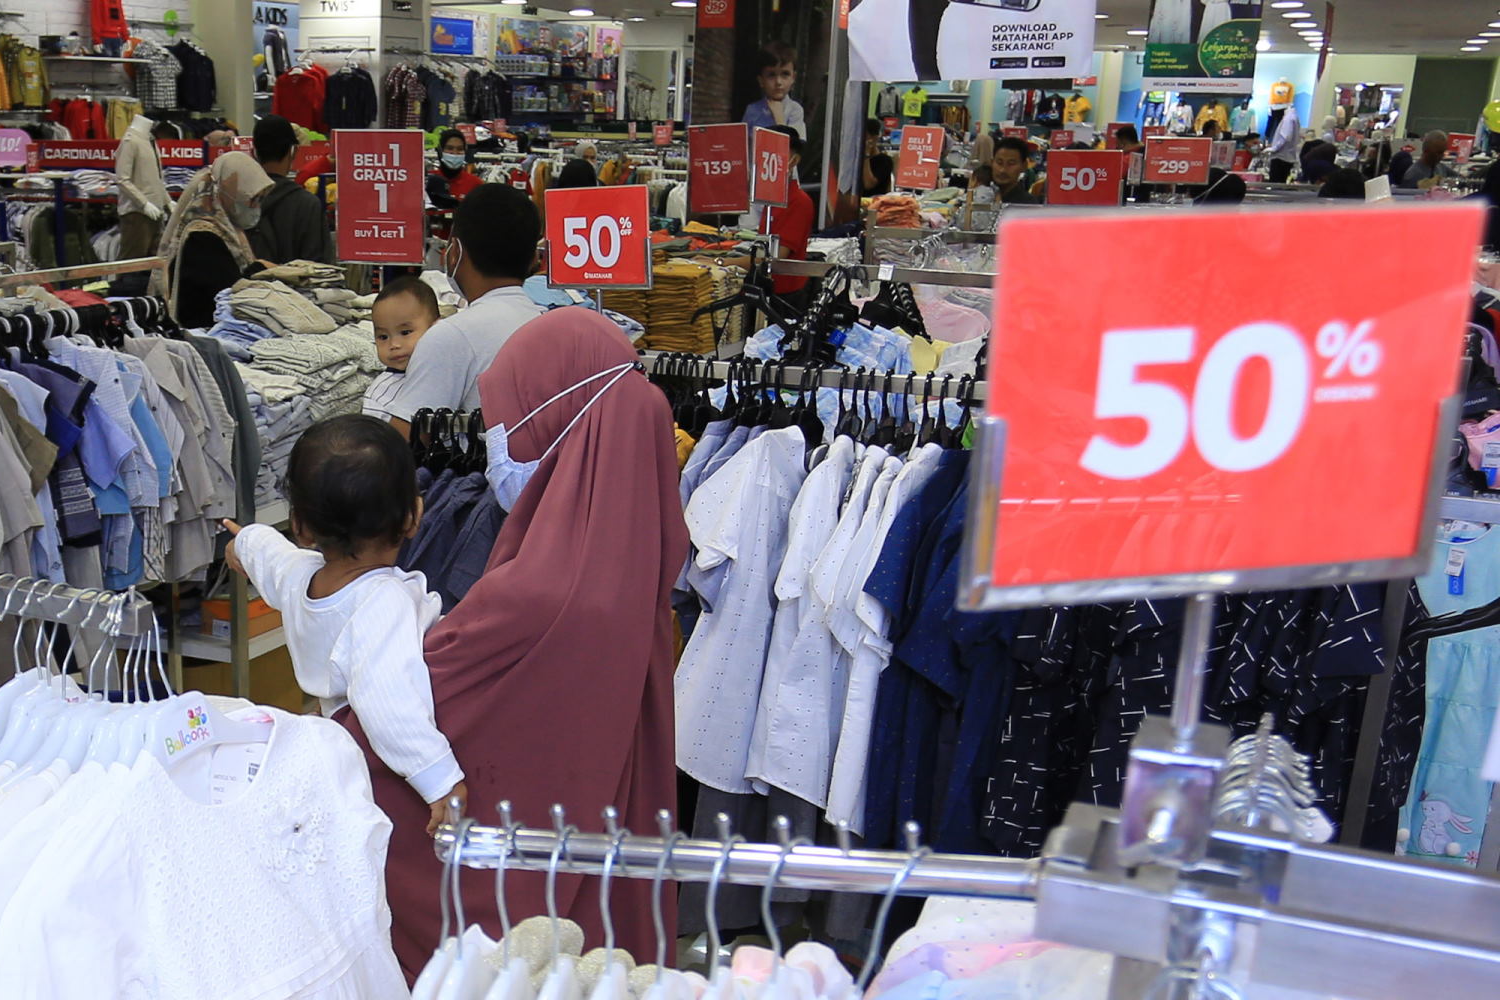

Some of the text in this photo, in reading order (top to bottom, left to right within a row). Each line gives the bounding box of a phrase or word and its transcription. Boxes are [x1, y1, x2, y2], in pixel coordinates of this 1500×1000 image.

[265, 7, 288, 25] KIDS
[992, 23, 1057, 33] DOWNLOAD
[992, 32, 1074, 42] MATAHARI APP
[991, 42, 1054, 52] SEKARANG!
[44, 148, 106, 160] CARDINAL
[171, 146, 203, 159] KIDS
[353, 143, 400, 167] BELI 1
[353, 169, 407, 181] GRATIS
[354, 225, 405, 238] BUY 1 GET 1
